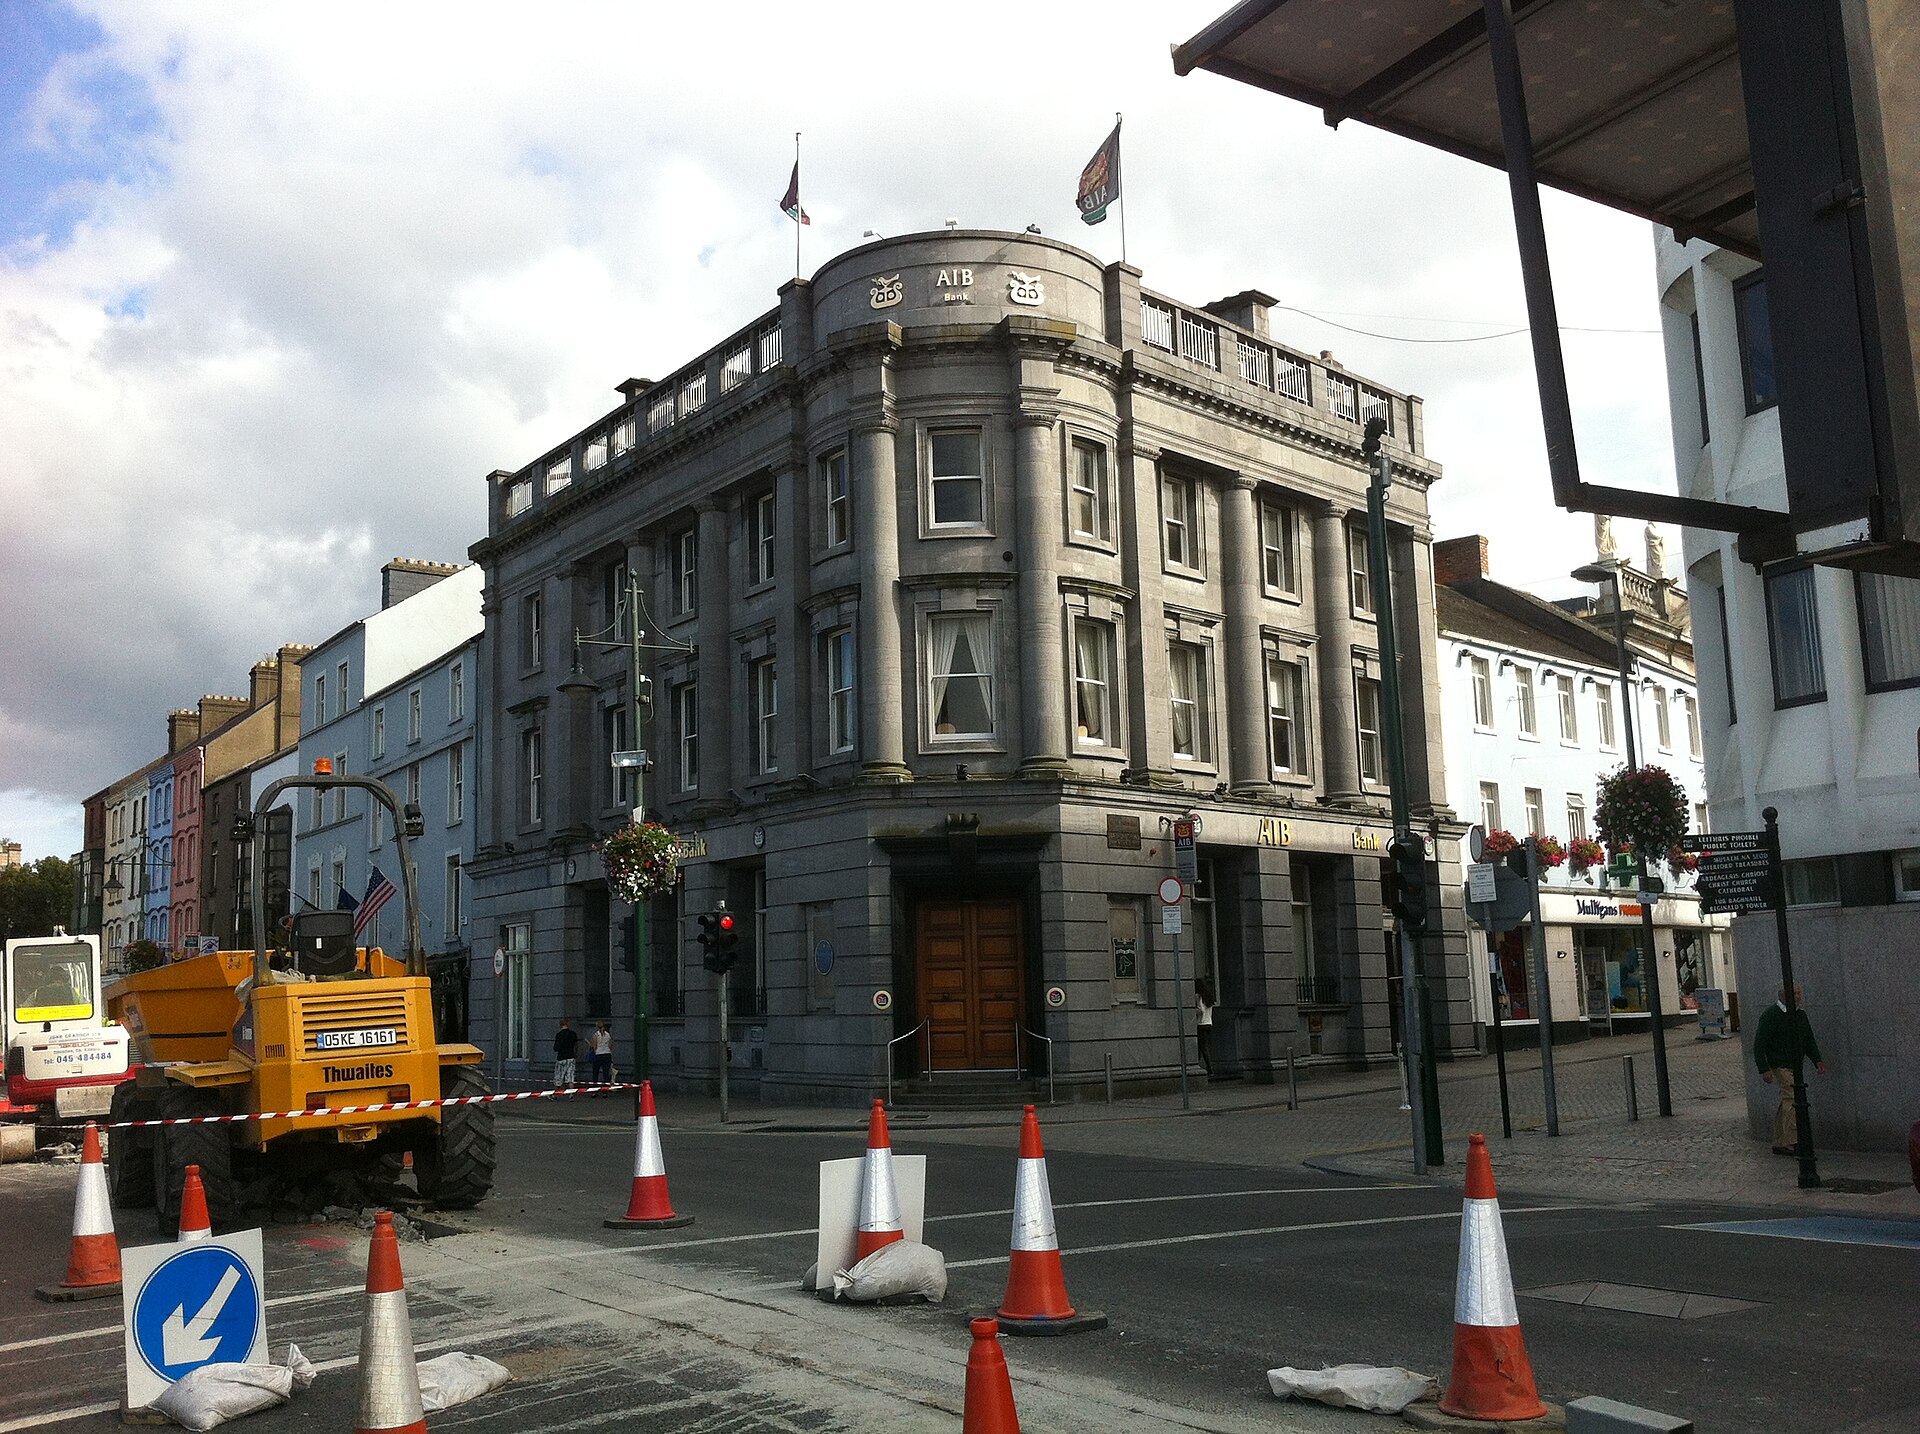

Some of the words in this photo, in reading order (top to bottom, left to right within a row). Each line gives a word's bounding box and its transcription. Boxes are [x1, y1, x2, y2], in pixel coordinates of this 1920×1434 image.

[936, 269, 974, 286] AIB
[944, 292, 969, 301] Bank
[1177, 838, 1191, 846] AIB
[1257, 818, 1292, 846] AIB
[1351, 831, 1380, 851] Bank
[1576, 899, 1618, 919] Mulligans
[359, 1030, 394, 1044] 16161
[56, 1054, 74, 1064] 045
[77, 1052, 112, 1062] 484484
[322, 1063, 394, 1083] Thwaites
